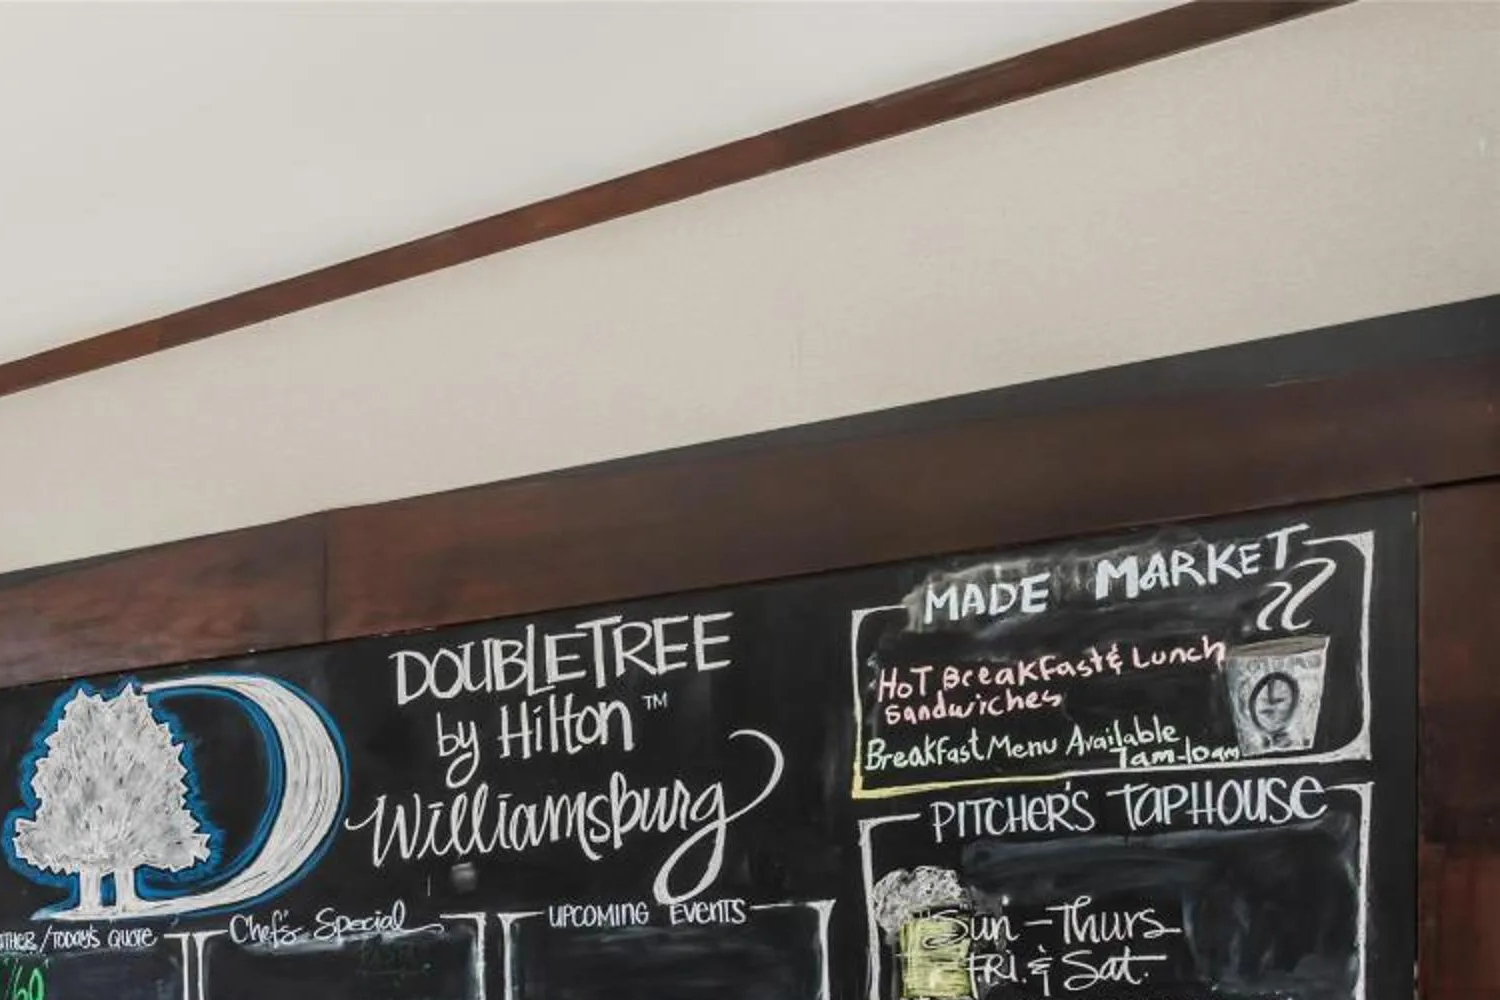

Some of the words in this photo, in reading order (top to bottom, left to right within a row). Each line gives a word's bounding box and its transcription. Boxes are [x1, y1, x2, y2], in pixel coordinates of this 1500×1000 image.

[923, 573, 1051, 625] MADE
[1095, 523, 1310, 600] MARKET
[388, 611, 734, 705] DOUBLETREE
[1132, 636, 1226, 671] Lunch
[436, 712, 480, 788] by
[498, 694, 635, 759] Hilton
[986, 734, 1057, 760] Menu
[1065, 713, 1182, 757] Available
[346, 729, 784, 905] Williamsburg
[229, 909, 303, 949] Chef's
[313, 898, 444, 940] Special
